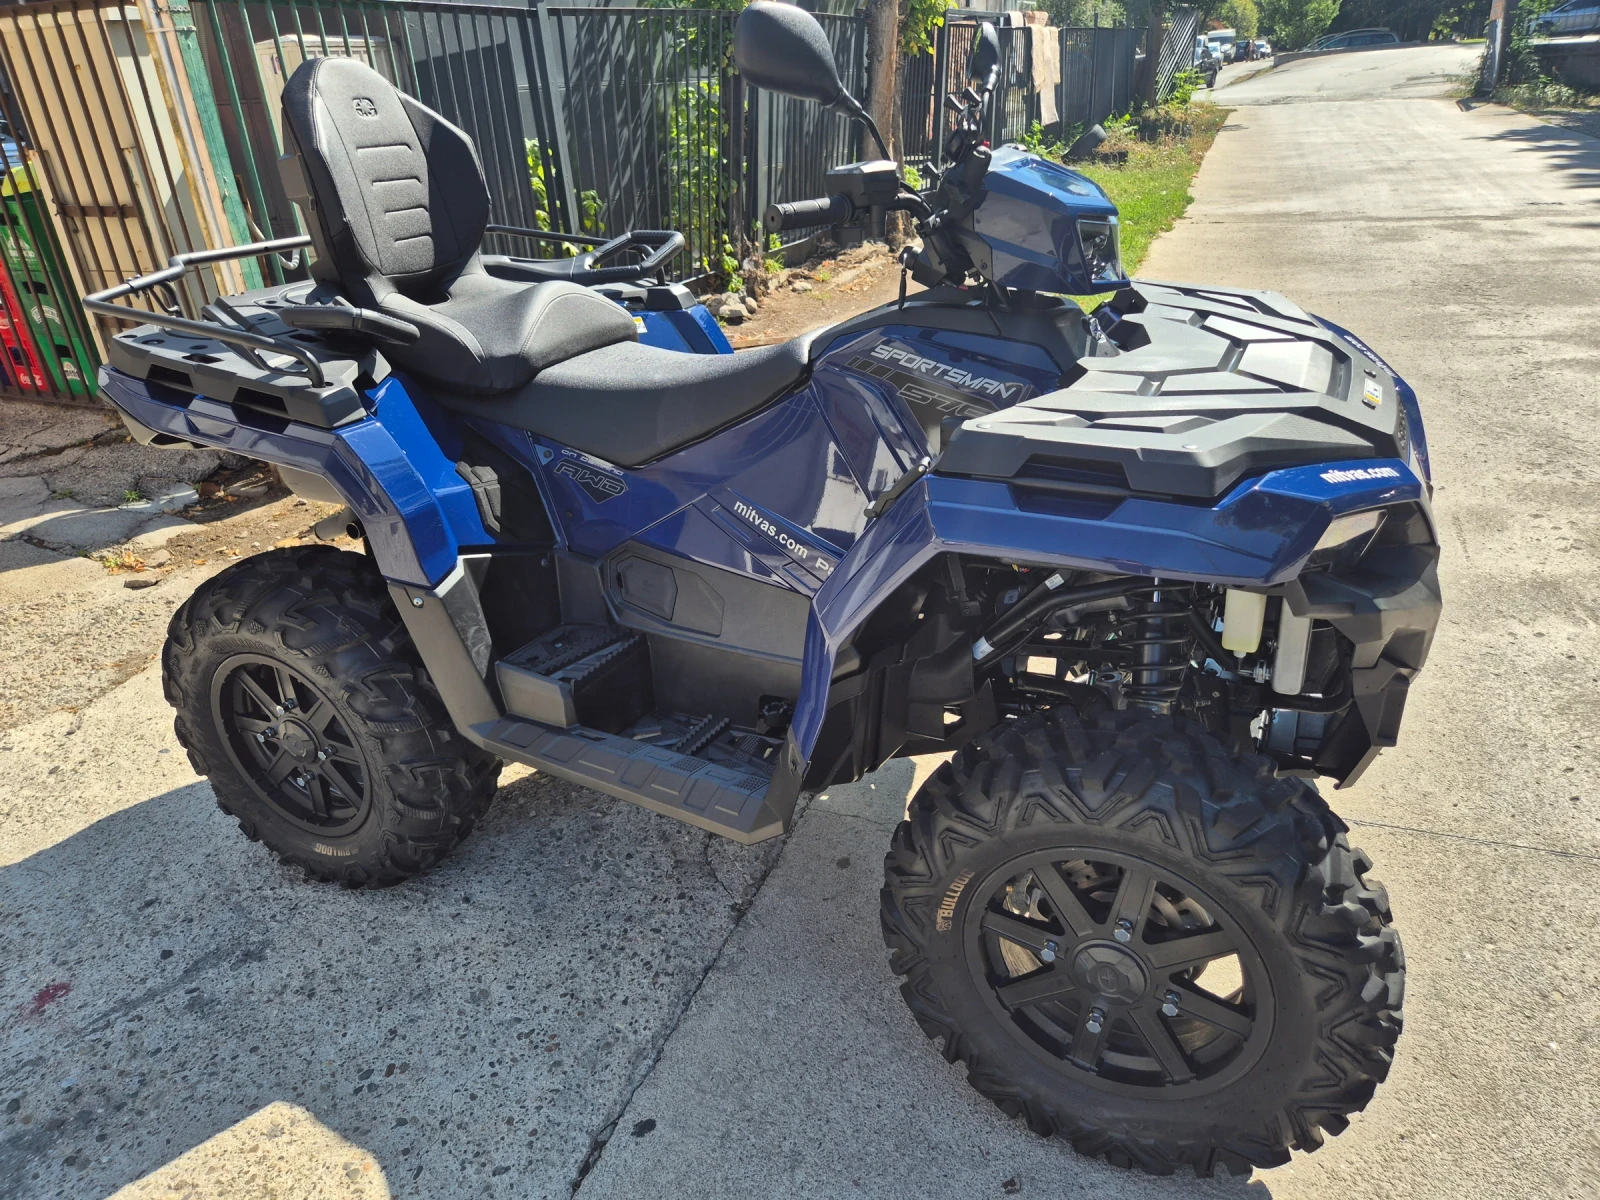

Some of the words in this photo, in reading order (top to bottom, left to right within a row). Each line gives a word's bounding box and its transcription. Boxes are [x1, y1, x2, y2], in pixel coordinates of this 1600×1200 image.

[870, 344, 1016, 399] SPORTSMAN
[553, 461, 626, 496] AWD
[1319, 467, 1400, 484] mitvas.com
[733, 501, 808, 559] mitvas.com
[940, 868, 976, 918] BULLDOG
